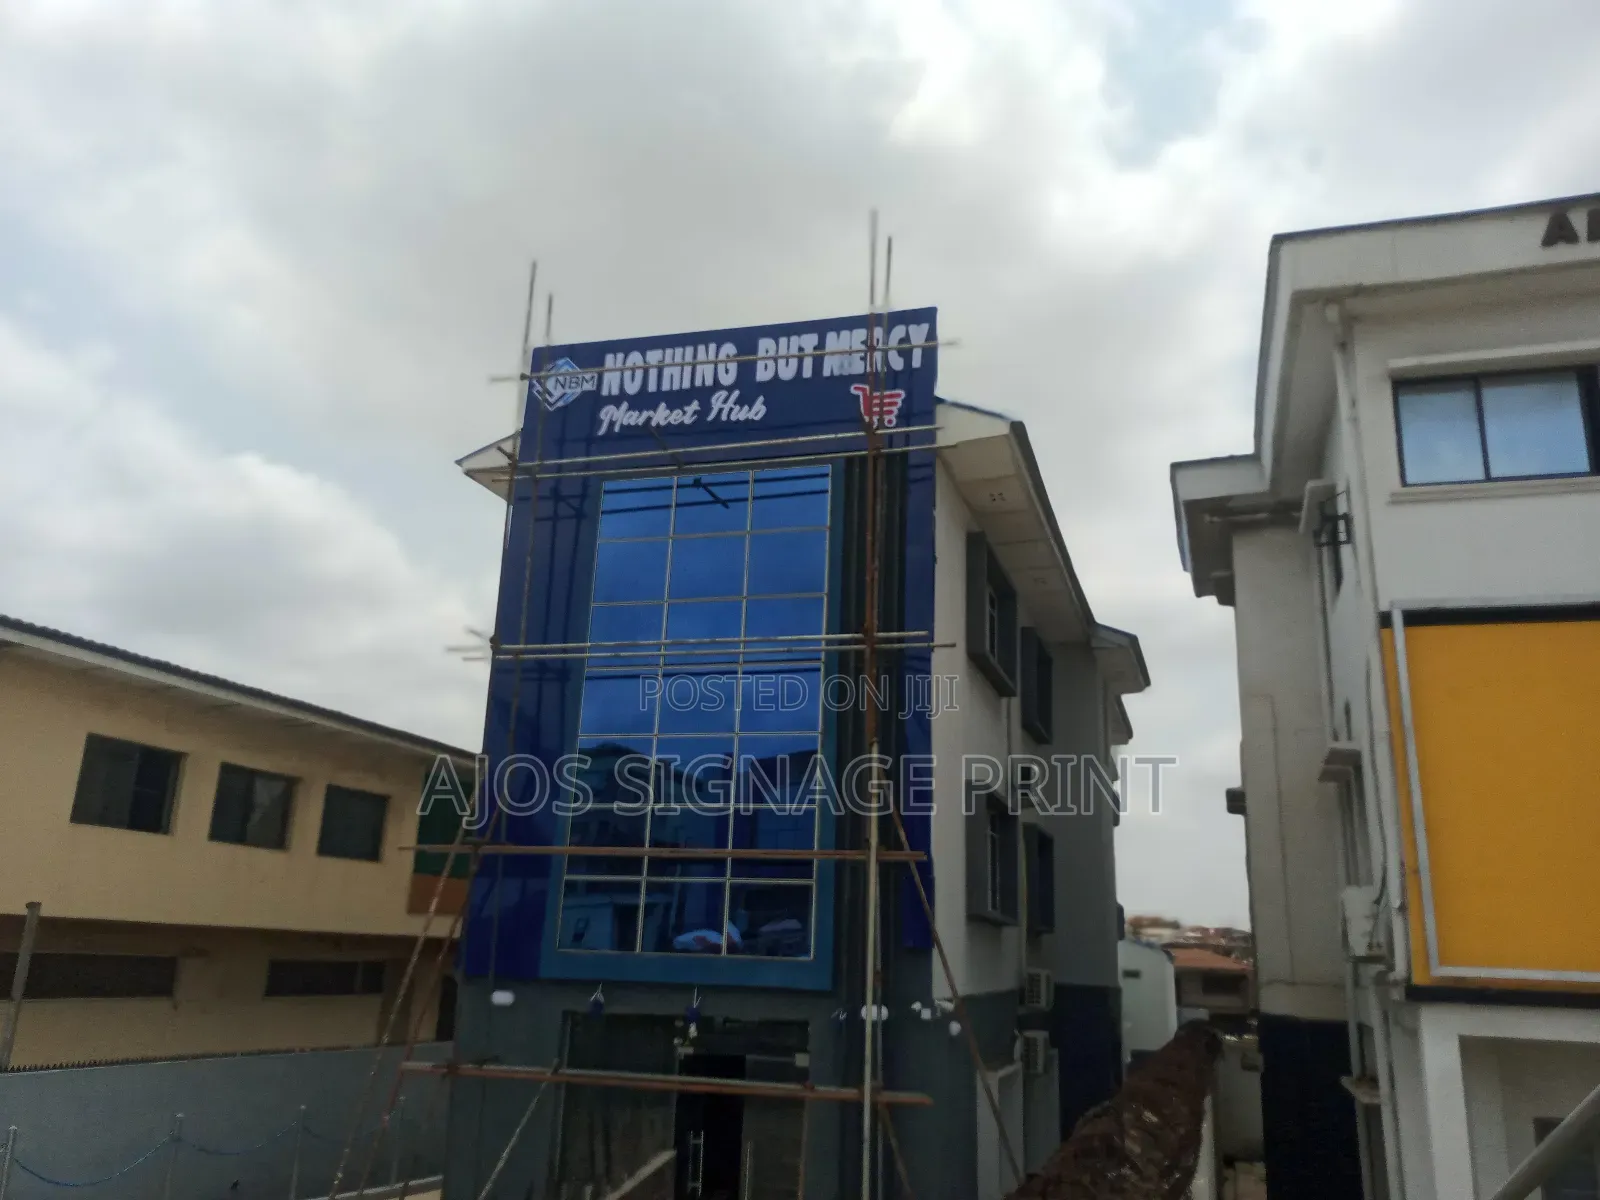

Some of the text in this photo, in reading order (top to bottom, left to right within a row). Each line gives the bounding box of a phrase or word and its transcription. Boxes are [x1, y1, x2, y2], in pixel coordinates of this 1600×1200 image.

[1541, 207, 1600, 248] A
[601, 322, 930, 397] NOTHING BUT MERCY
[554, 374, 597, 391] NBM
[597, 389, 767, 436] Market Hub
